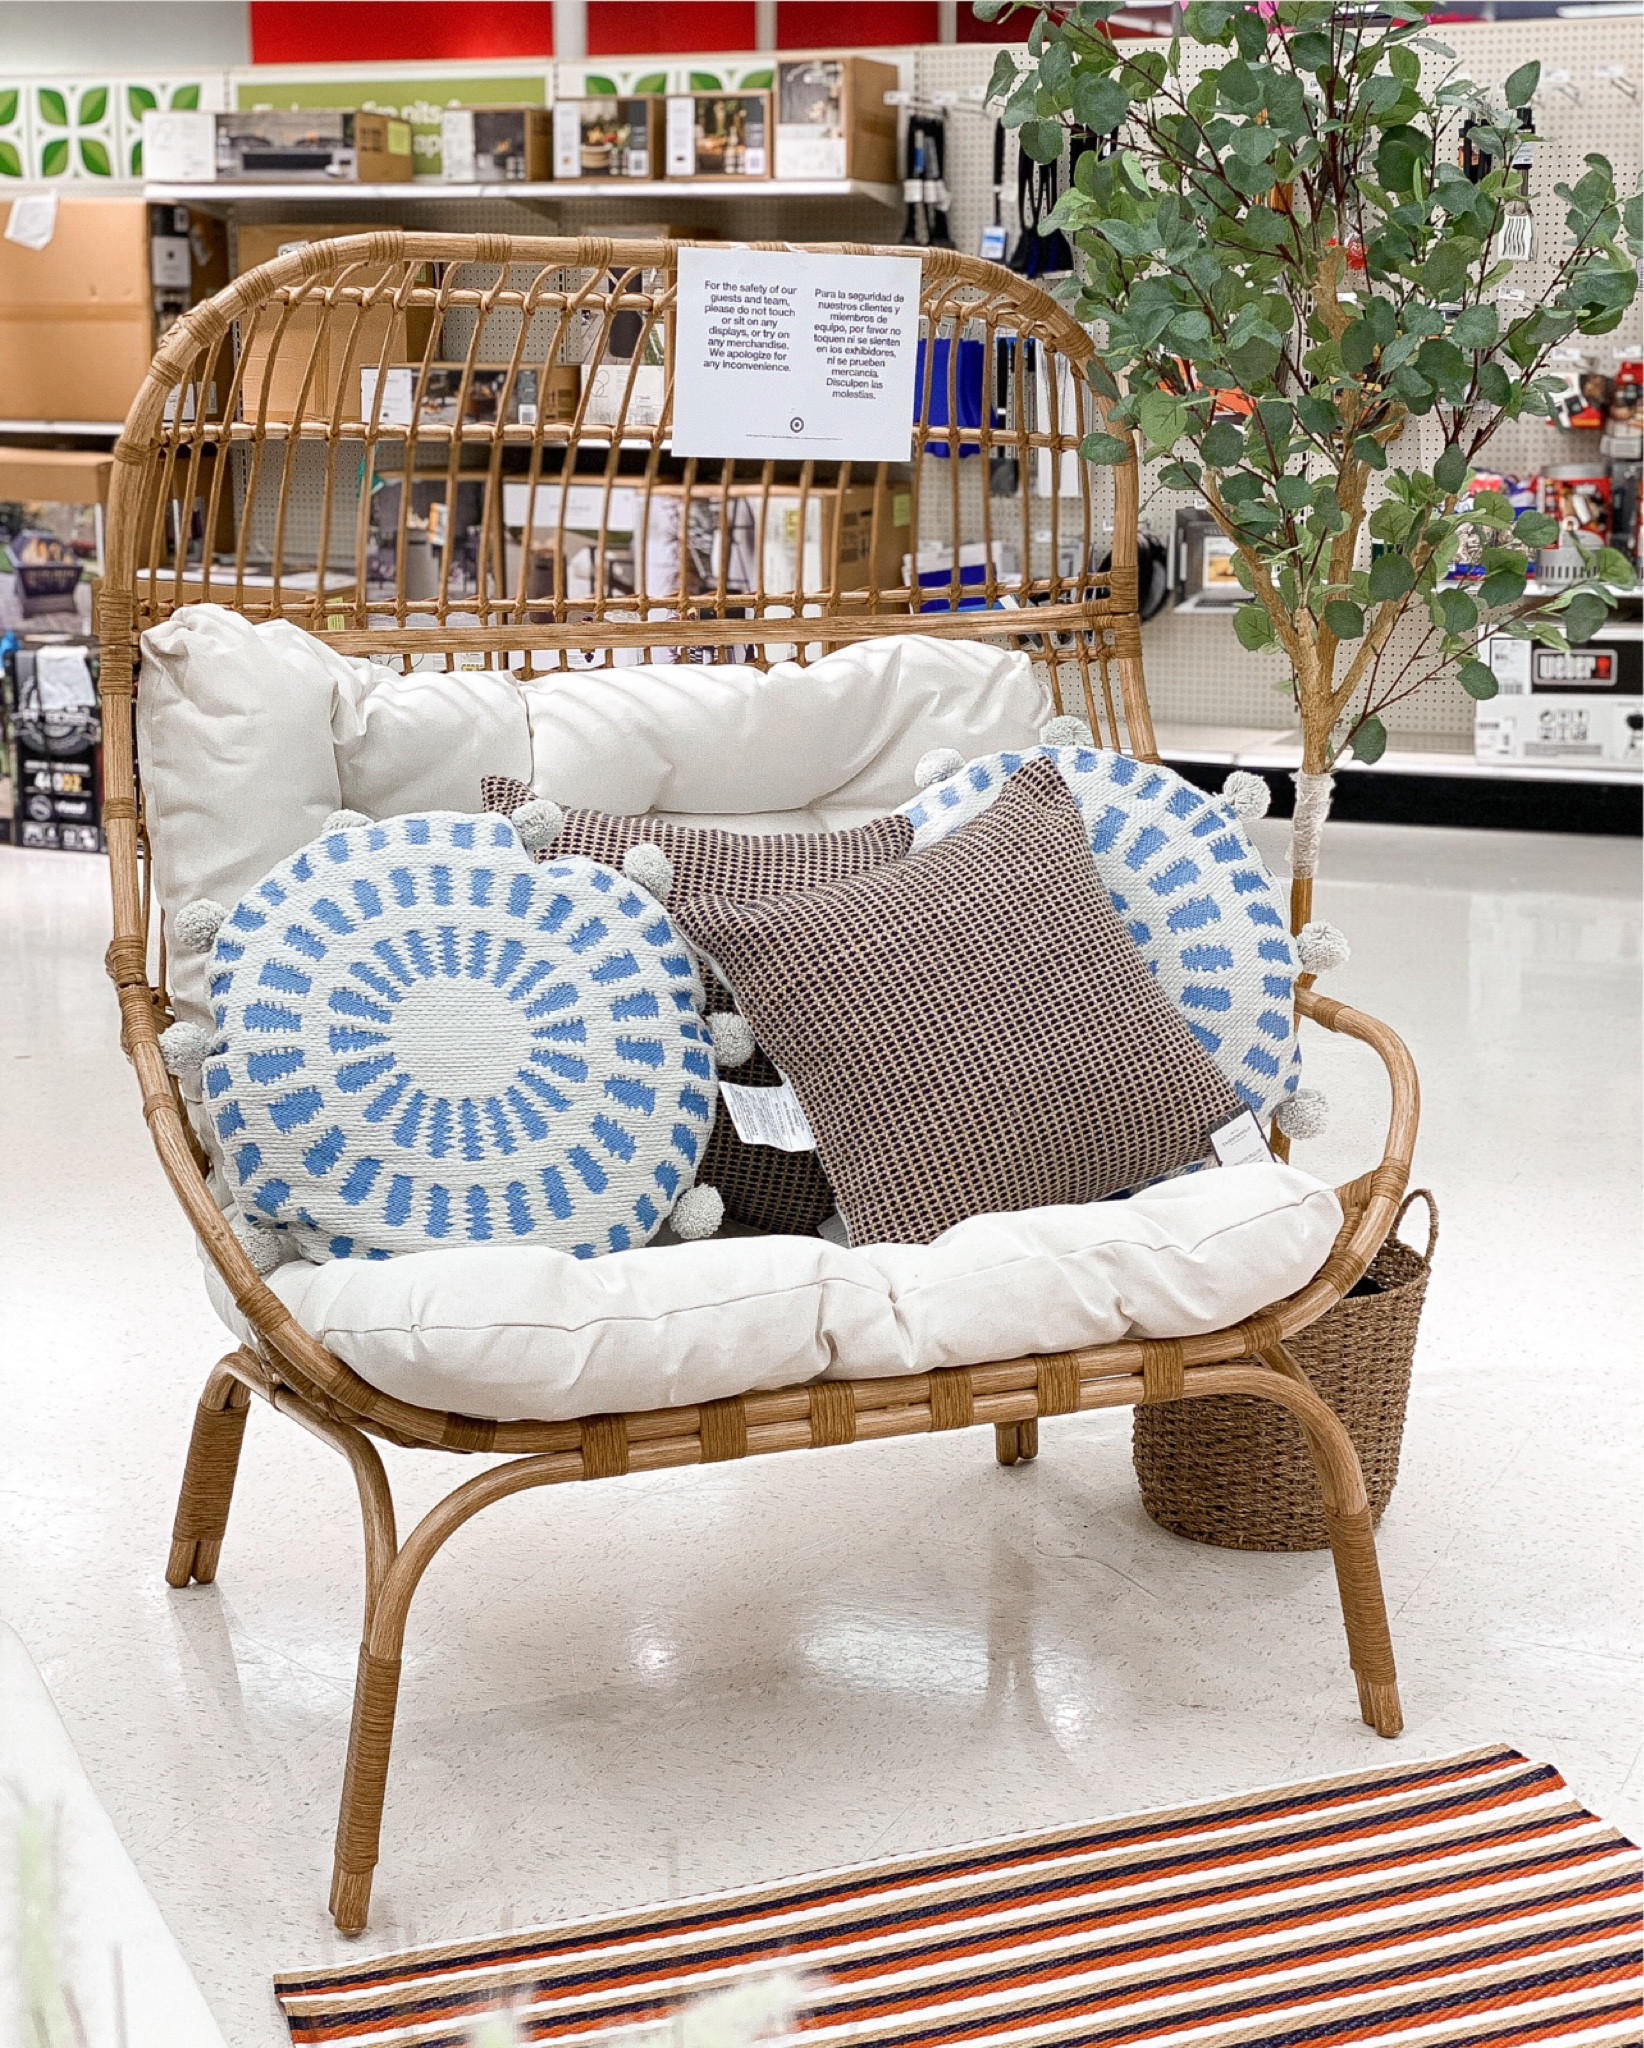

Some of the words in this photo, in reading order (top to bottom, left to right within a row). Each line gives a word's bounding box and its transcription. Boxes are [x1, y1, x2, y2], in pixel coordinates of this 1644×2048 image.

[705, 280, 720, 290] For
[723, 282, 737, 291] the
[740, 283, 767, 294] safety
[769, 285, 779, 293] of
[711, 294, 741, 302] guests
[764, 296, 790, 306] team,
[815, 288, 836, 298] Para
[838, 290, 845, 298] la
[848, 292, 891, 302] seguridad
[894, 294, 904, 302] de
[705, 304, 735, 314] please
[737, 306, 749, 314] do
[751, 307, 766, 315] not
[769, 307, 795, 316] touch
[818, 302, 857, 310] nuestros
[860, 303, 892, 312] clientes
[895, 306, 900, 315] y
[734, 316, 745, 325] sit
[747, 318, 758, 326] on
[761, 320, 778, 328] any
[830, 312, 874, 322] miembros
[877, 315, 887, 324] de
[709, 326, 749, 338] displays,
[763, 329, 776, 339] try
[814, 323, 847, 333] equipo,
[850, 326, 864, 334] por
[866, 325, 888, 334] favor
[708, 339, 724, 348] any
[727, 339, 789, 350] merchandise.
[814, 334, 845, 344] toquen
[847, 335, 855, 343] ni
[870, 337, 900, 346] sienten
[709, 348, 724, 357] We
[727, 350, 772, 361] apologize
[774, 352, 787, 360] for
[830, 345, 842, 353] los
[845, 346, 896, 358] exhibidores,
[704, 360, 720, 370] any
[723, 360, 791, 371] inconvenience.
[827, 356, 836, 364] ni
[849, 358, 886, 367] prueben
[826, 377, 869, 388] Disculpen
[872, 380, 883, 389] las
[832, 389, 876, 399] molestias.
